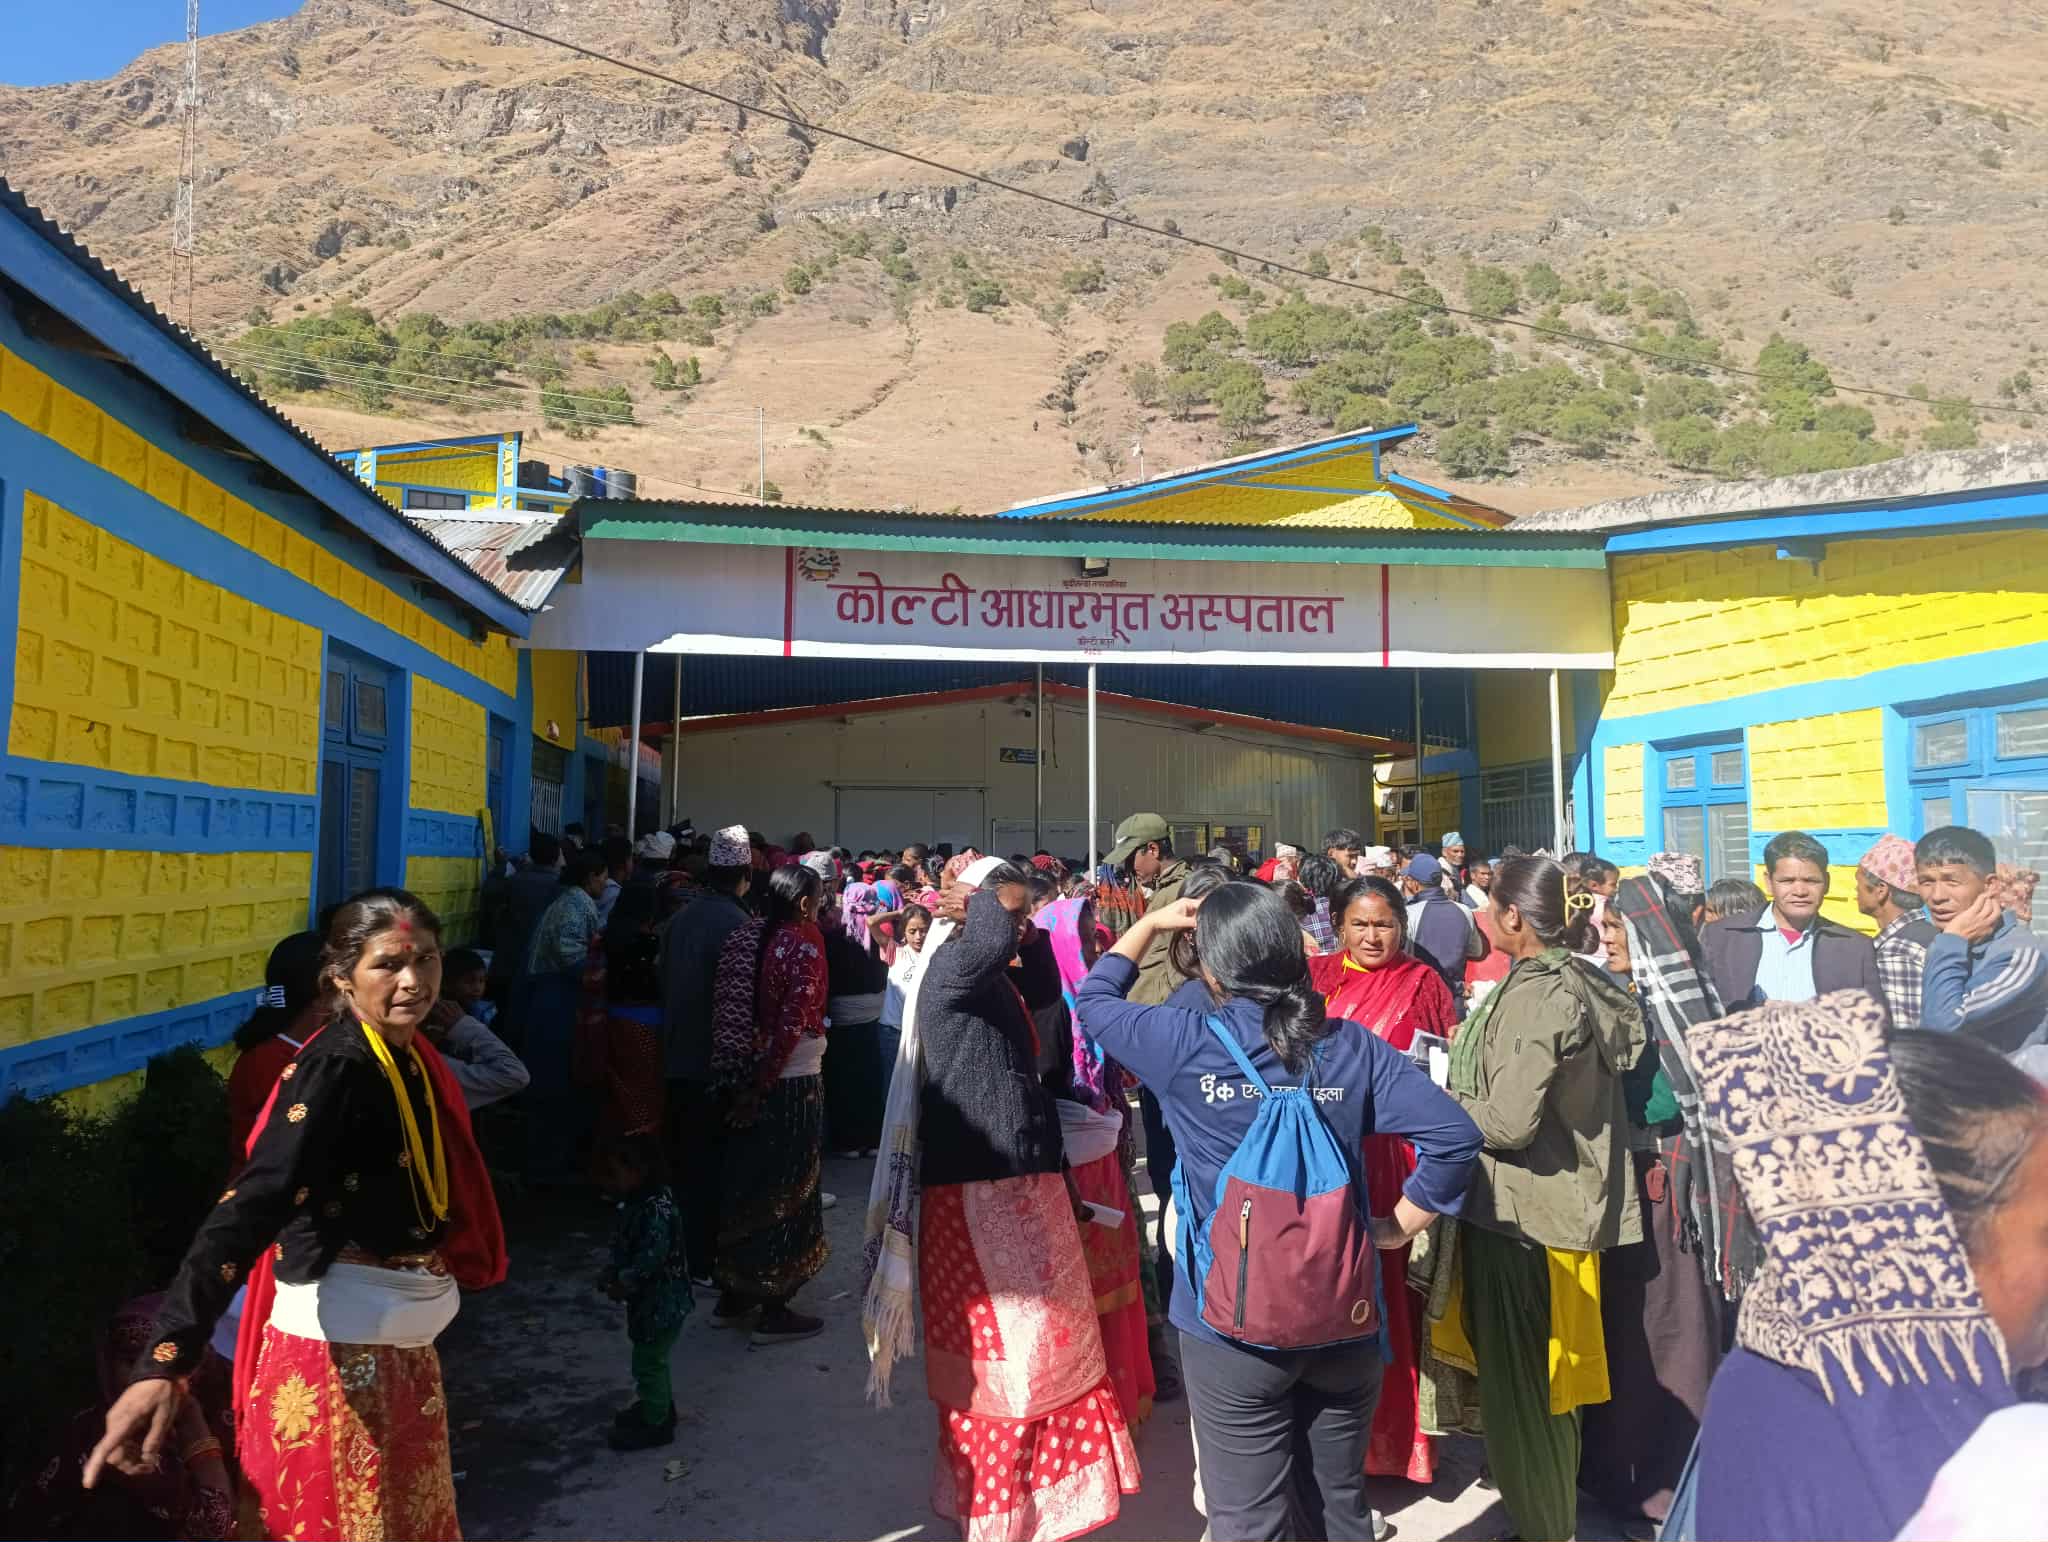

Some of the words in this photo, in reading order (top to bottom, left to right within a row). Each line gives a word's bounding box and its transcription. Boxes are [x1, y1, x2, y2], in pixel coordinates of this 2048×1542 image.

[827, 571, 976, 628] कोल्टी
[981, 588, 1154, 644] आधारभूत
[1160, 593, 1344, 634] अस्पताल
